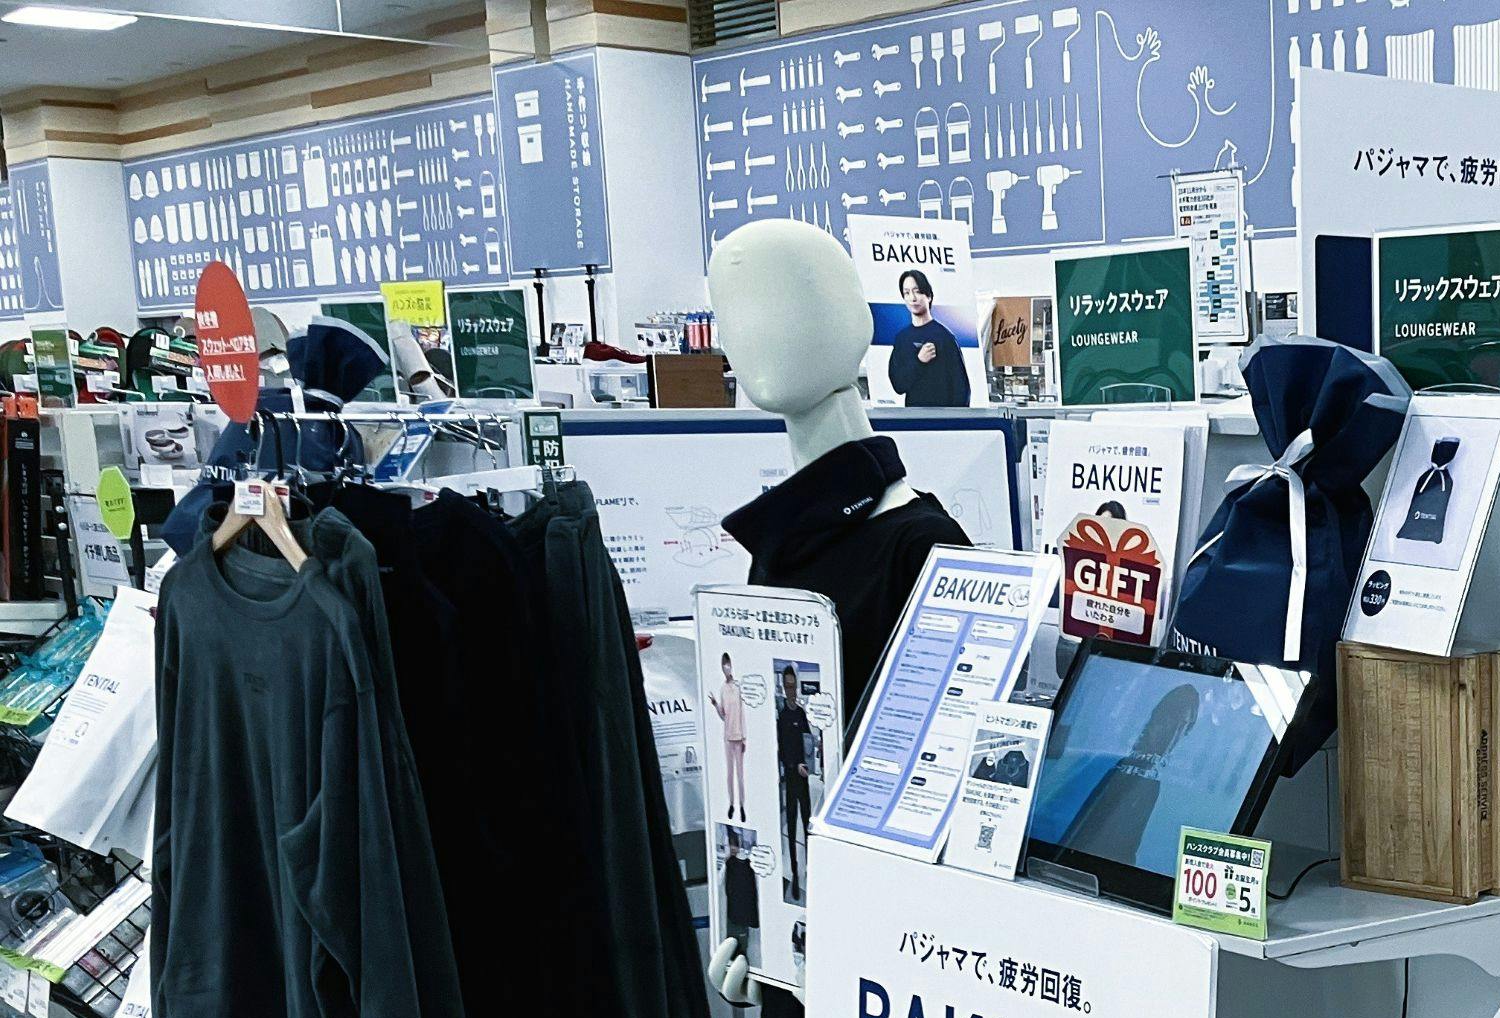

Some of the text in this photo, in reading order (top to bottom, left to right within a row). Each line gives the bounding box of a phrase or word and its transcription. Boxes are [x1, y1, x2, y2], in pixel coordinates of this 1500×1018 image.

[565, 79, 584, 249] HANDMADE STORAGE
[872, 243, 955, 265] BAKUNE
[1069, 288, 1169, 316] リラックスウェア
[457, 318, 514, 333] リラックスウェア
[1394, 322, 1476, 338] LOUNGEWEAR
[1071, 331, 1139, 347] LOUNGEWEAR
[1072, 463, 1162, 494] BAKUNE
[933, 577, 1010, 605] BAKUNE
[1073, 558, 1150, 604] GIFT
[1085, 610, 1115, 624] いたわる
[1086, 599, 1131, 617] 疲れた自分を
[83, 674, 121, 694] TENTIAL
[647, 698, 692, 716] NTIAL
[1184, 868, 1217, 899] 100
[898, 930, 1092, 1015] パジャマで、疲労回復。
